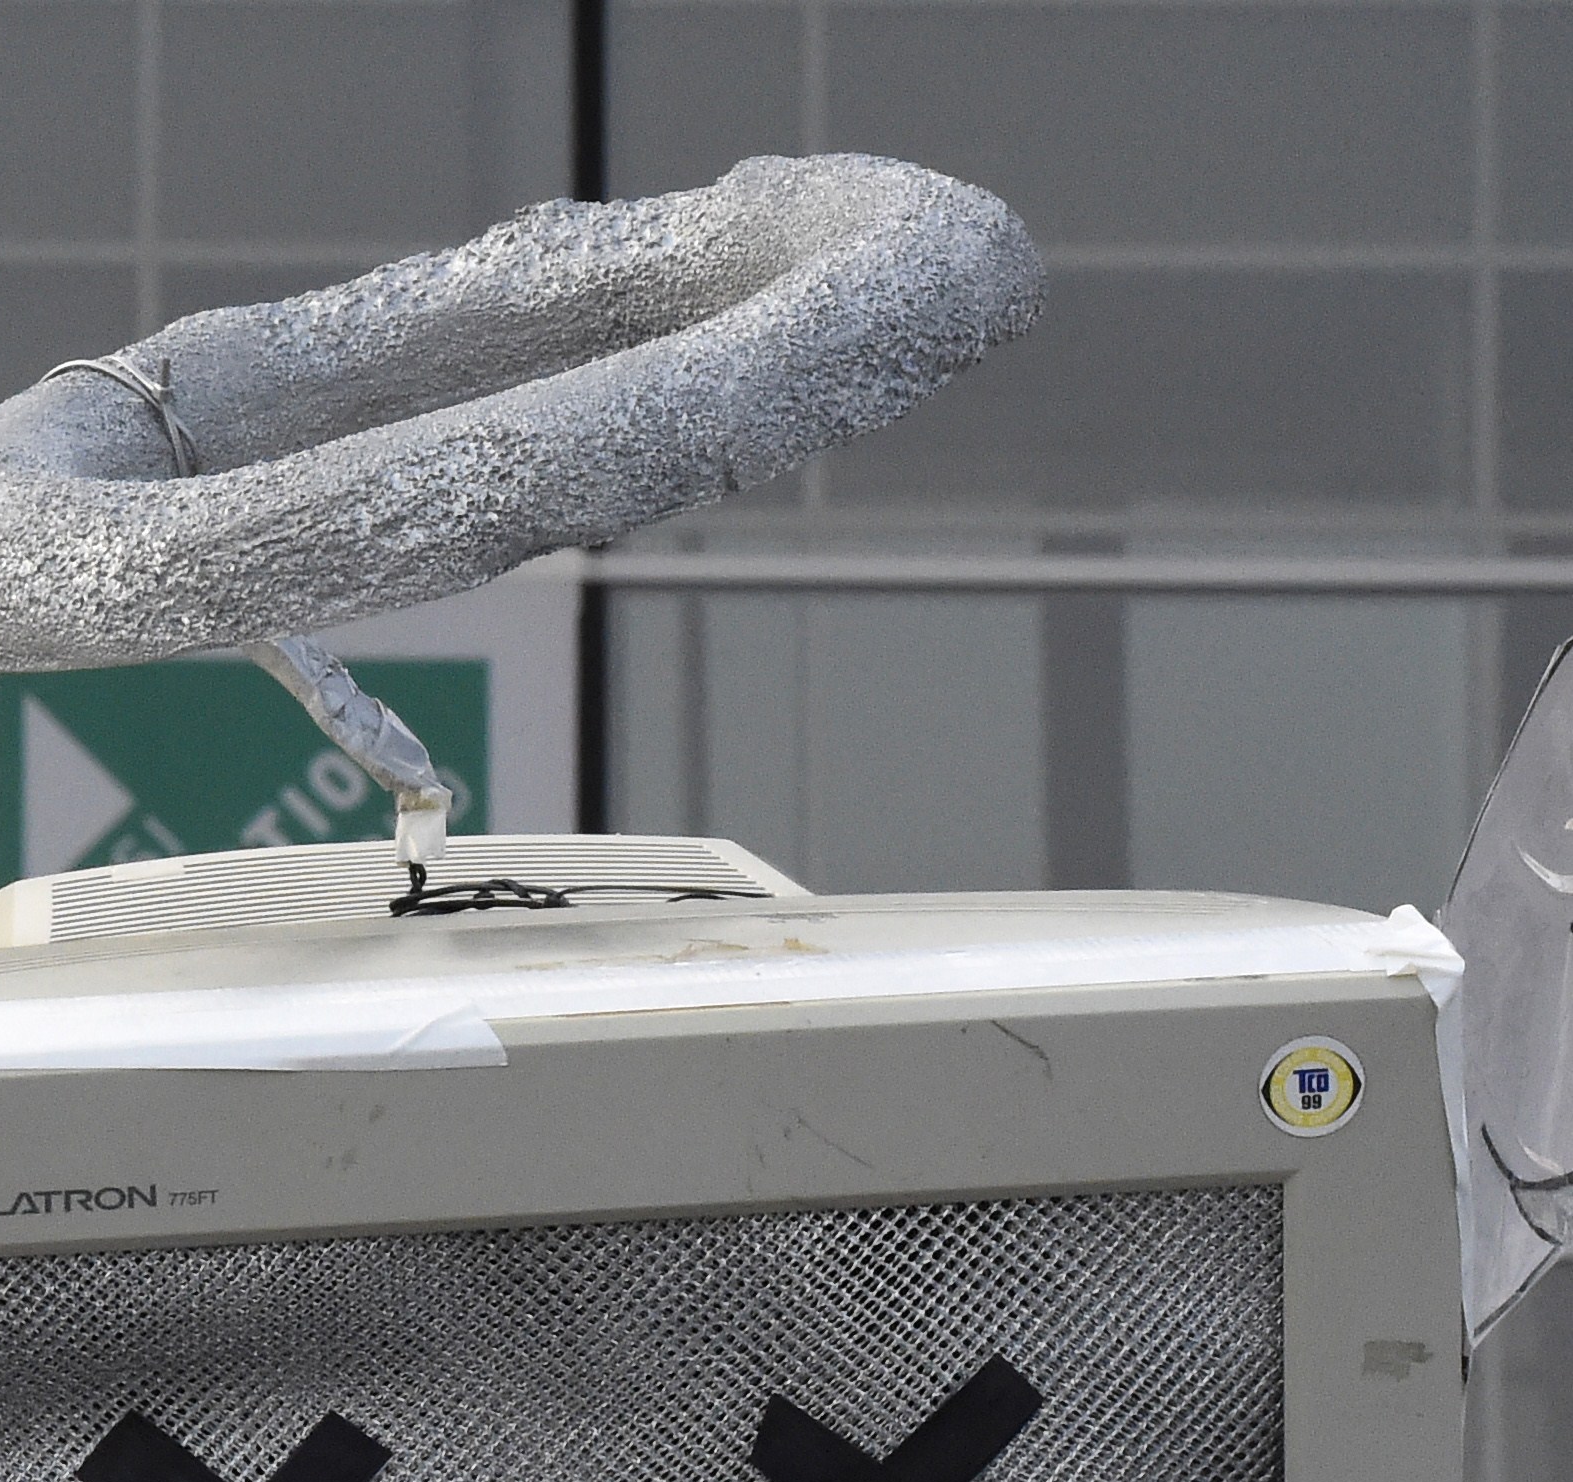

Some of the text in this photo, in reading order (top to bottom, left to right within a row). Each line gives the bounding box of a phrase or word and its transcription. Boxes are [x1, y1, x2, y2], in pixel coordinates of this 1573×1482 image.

[1293, 1068, 1330, 1094] TCO
[1301, 1094, 1323, 1110] 99
[168, 1189, 219, 1206] 775FT
